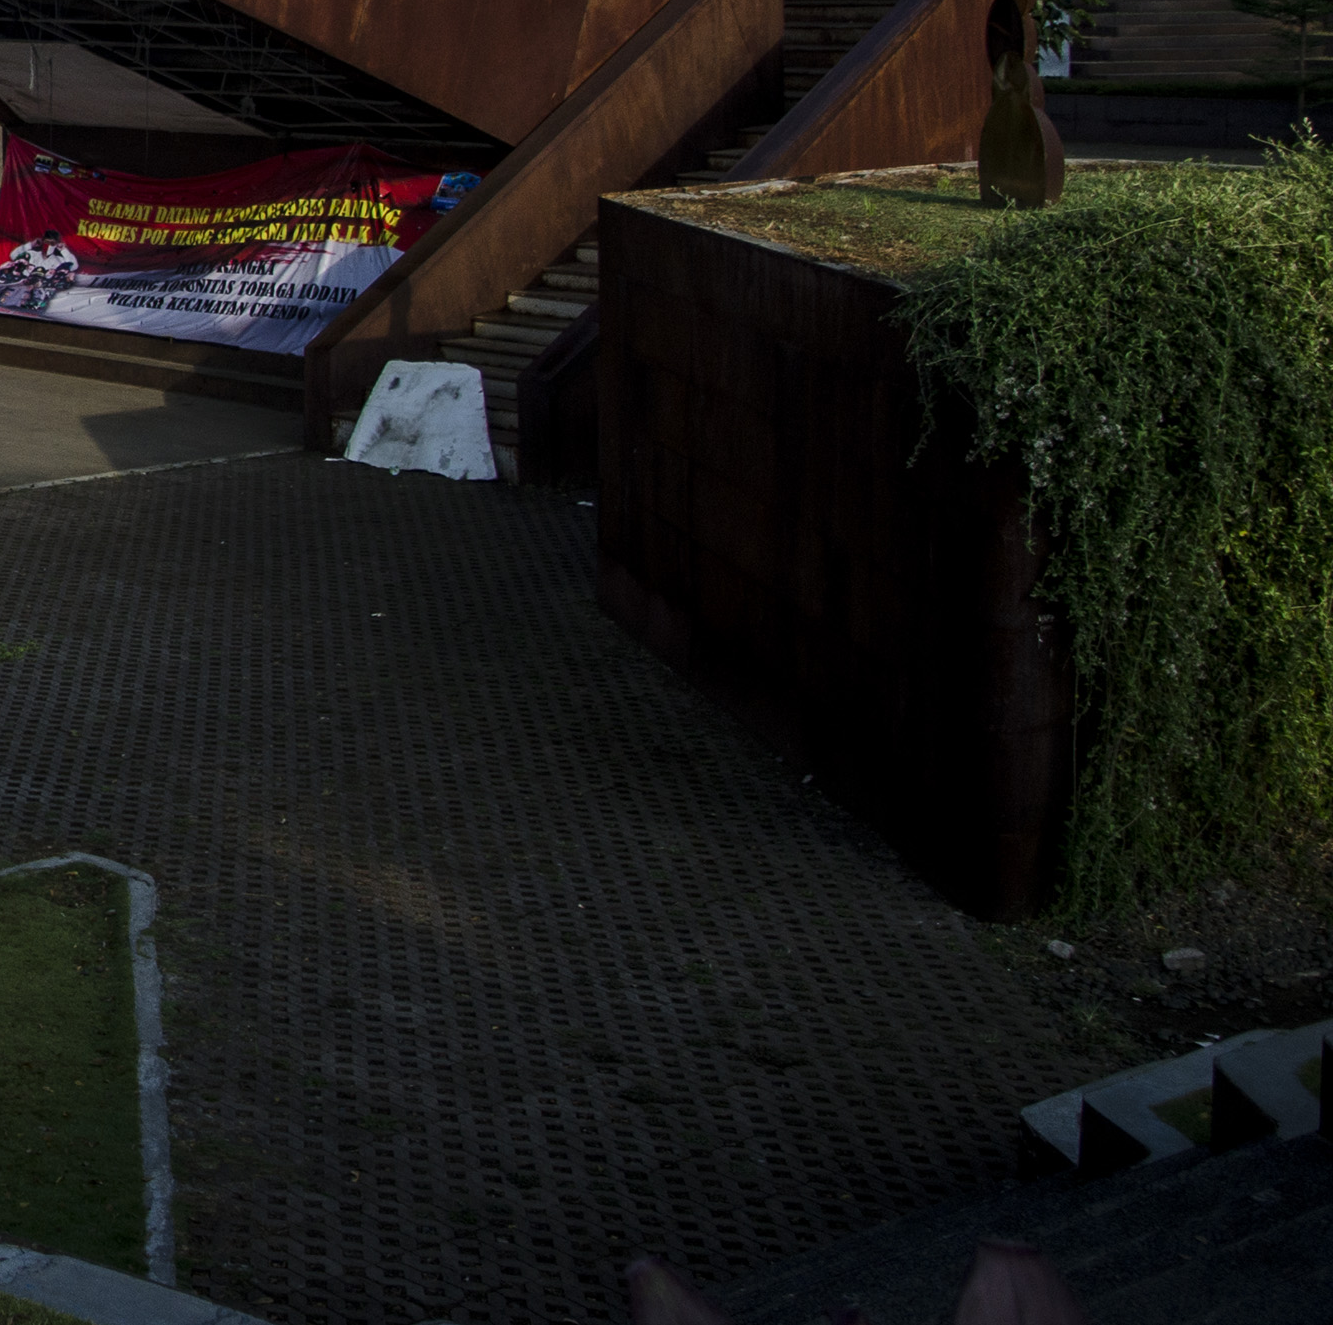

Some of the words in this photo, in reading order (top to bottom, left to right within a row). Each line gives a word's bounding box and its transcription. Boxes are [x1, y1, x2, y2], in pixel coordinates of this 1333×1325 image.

[88, 198, 153, 222] SELAMAT
[154, 205, 211, 224] DATANG
[76, 218, 139, 244] KOMBES
[139, 228, 171, 245] POL
[216, 259, 275, 275] RANGKA
[237, 280, 296, 298] TOHAGA
[297, 283, 358, 304] LODAYA
[166, 296, 249, 316] KECAMATAN
